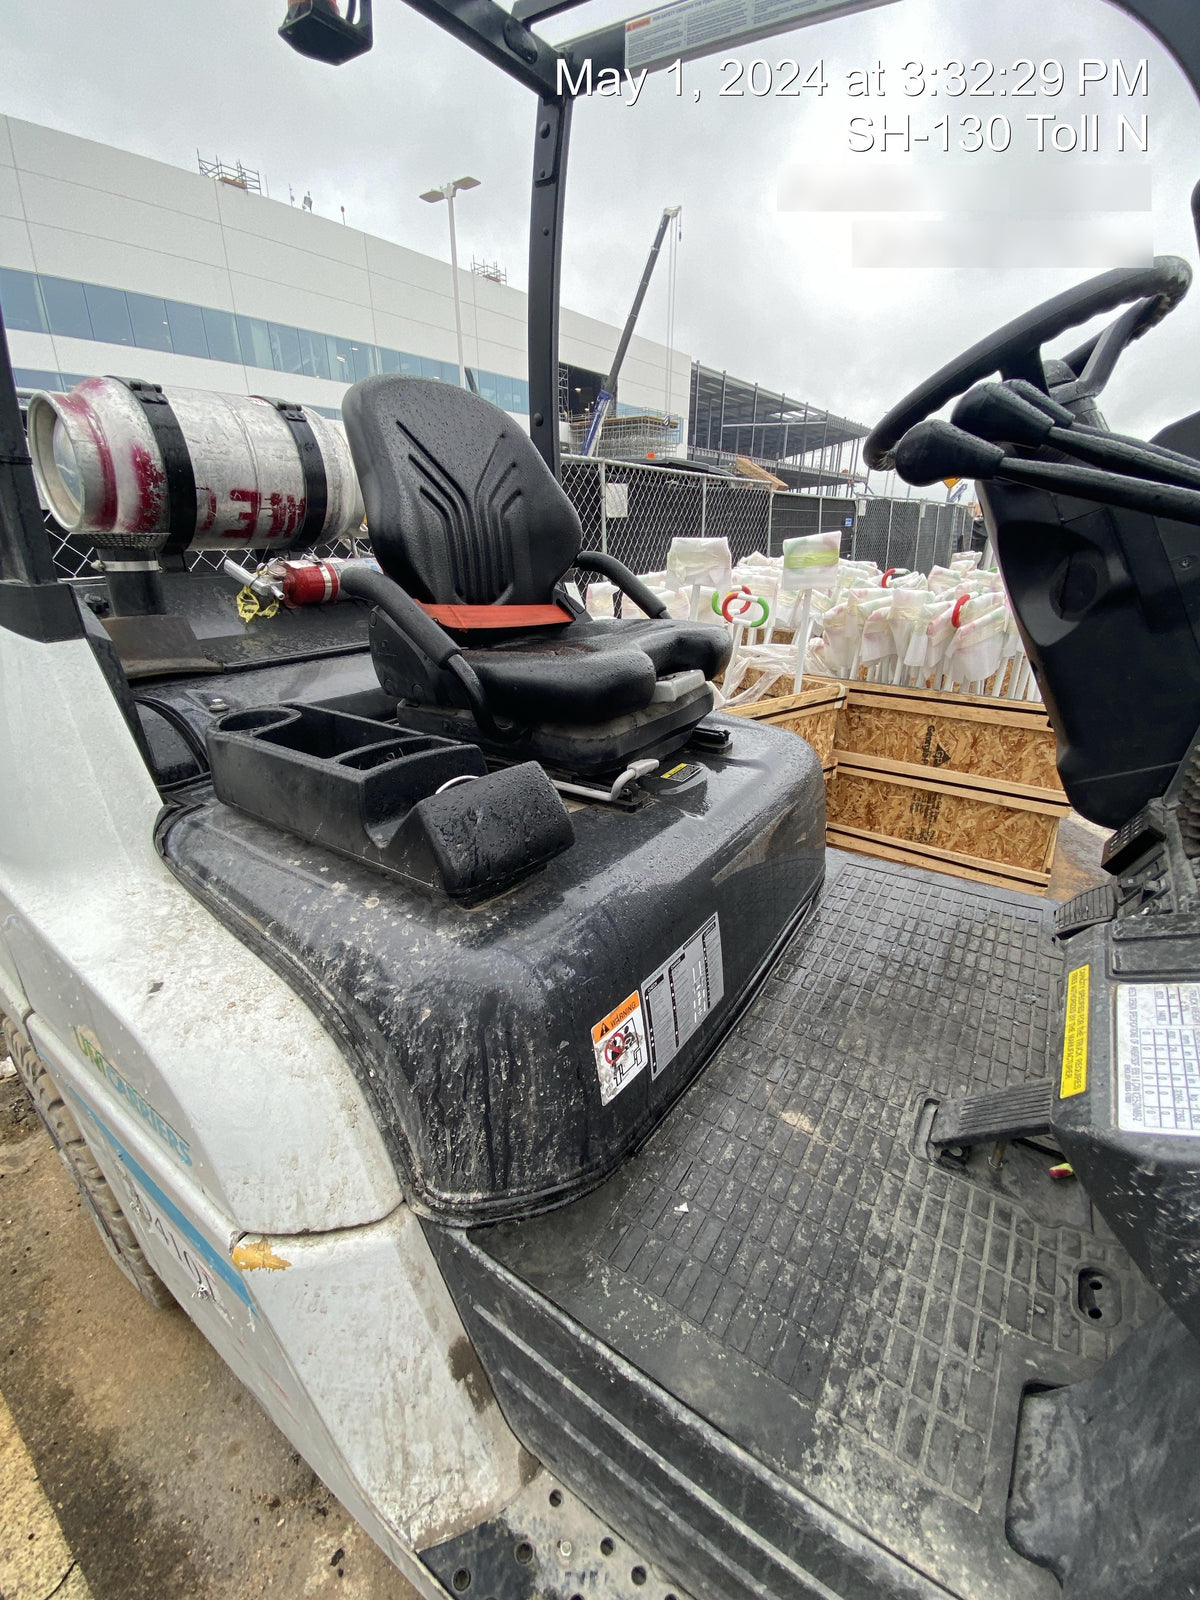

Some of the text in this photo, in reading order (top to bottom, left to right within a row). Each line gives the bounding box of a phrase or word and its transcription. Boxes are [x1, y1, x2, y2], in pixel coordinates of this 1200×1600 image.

[1069, 986, 1077, 1013] AUTHORIZED
[1077, 989, 1085, 1013] SPECIFIED
[610, 1001, 637, 1028] WARNING
[1067, 1023, 1075, 1033] THE
[1066, 1034, 1074, 1078] MANUFACTURER
[1075, 1039, 1083, 1056] TRUCK
[1074, 1059, 1082, 1089] REQUIRES
